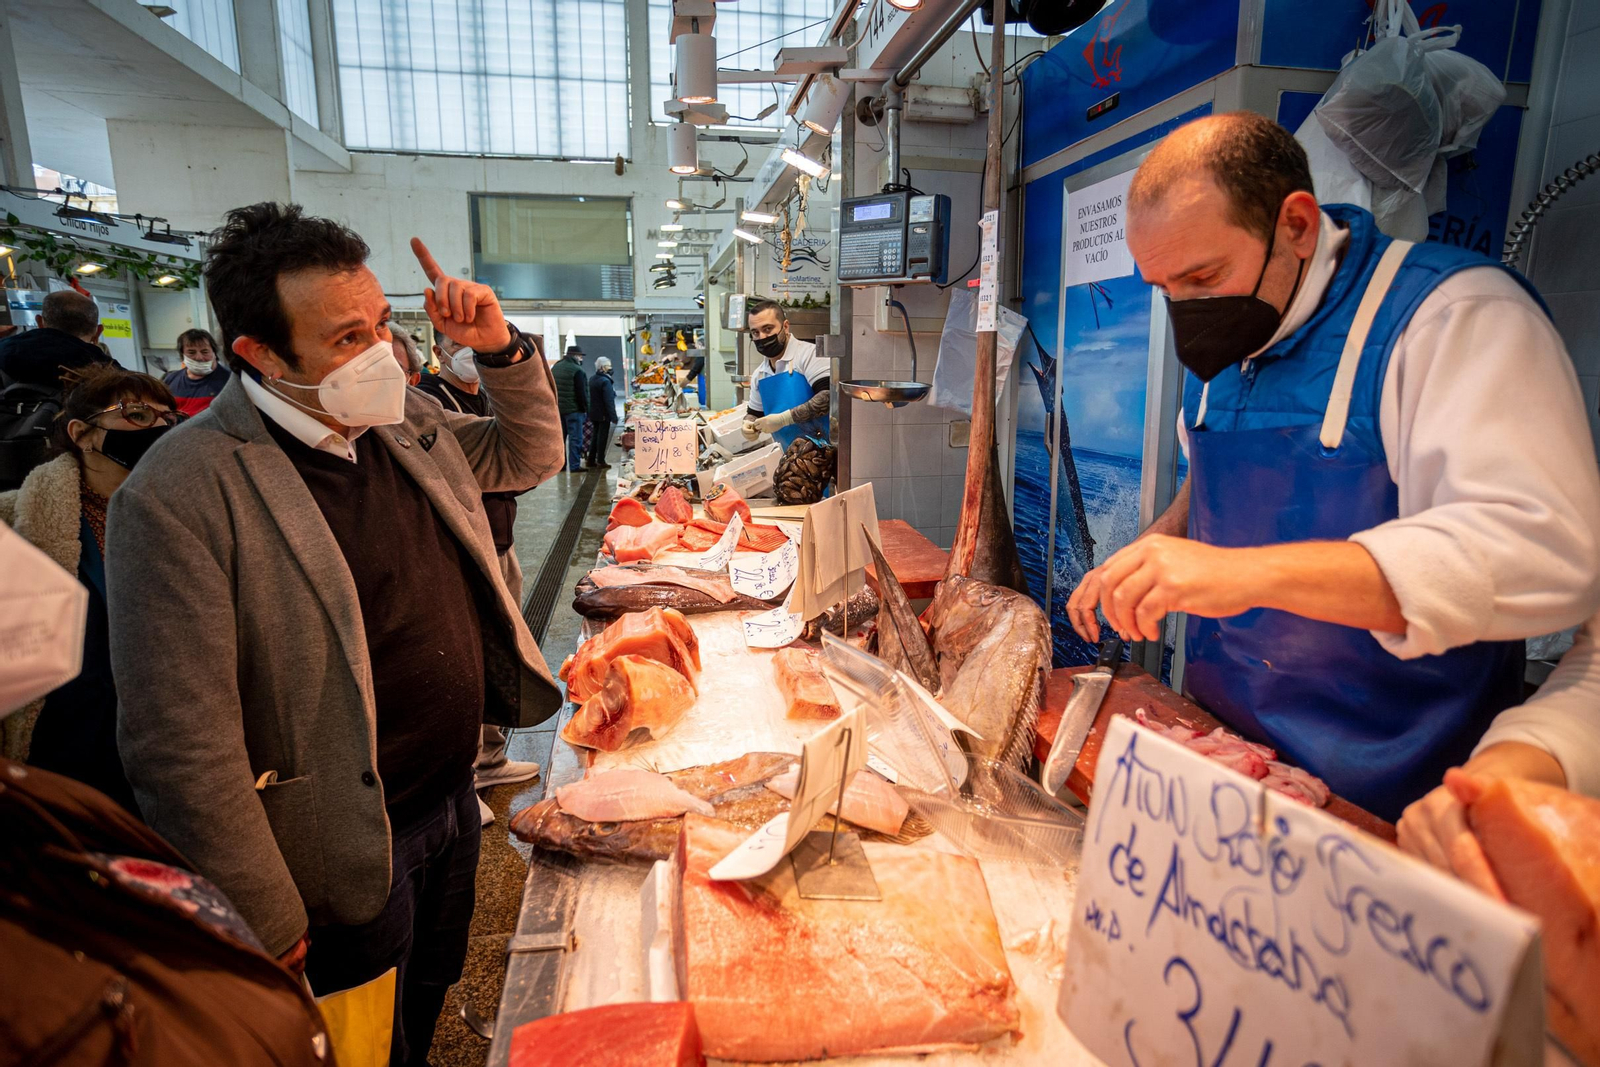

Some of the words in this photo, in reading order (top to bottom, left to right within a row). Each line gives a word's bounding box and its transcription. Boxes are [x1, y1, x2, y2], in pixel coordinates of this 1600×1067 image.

[1078, 195, 1122, 219] ENVASAMOS
[1080, 213, 1117, 235] NUESTROS
[776, 238, 827, 247] PCADERIA
[1072, 231, 1114, 252] PRODUCTOS
[1114, 228, 1125, 242] AL
[1085, 247, 1108, 264] VACÍO
[1108, 822, 1147, 898] de
